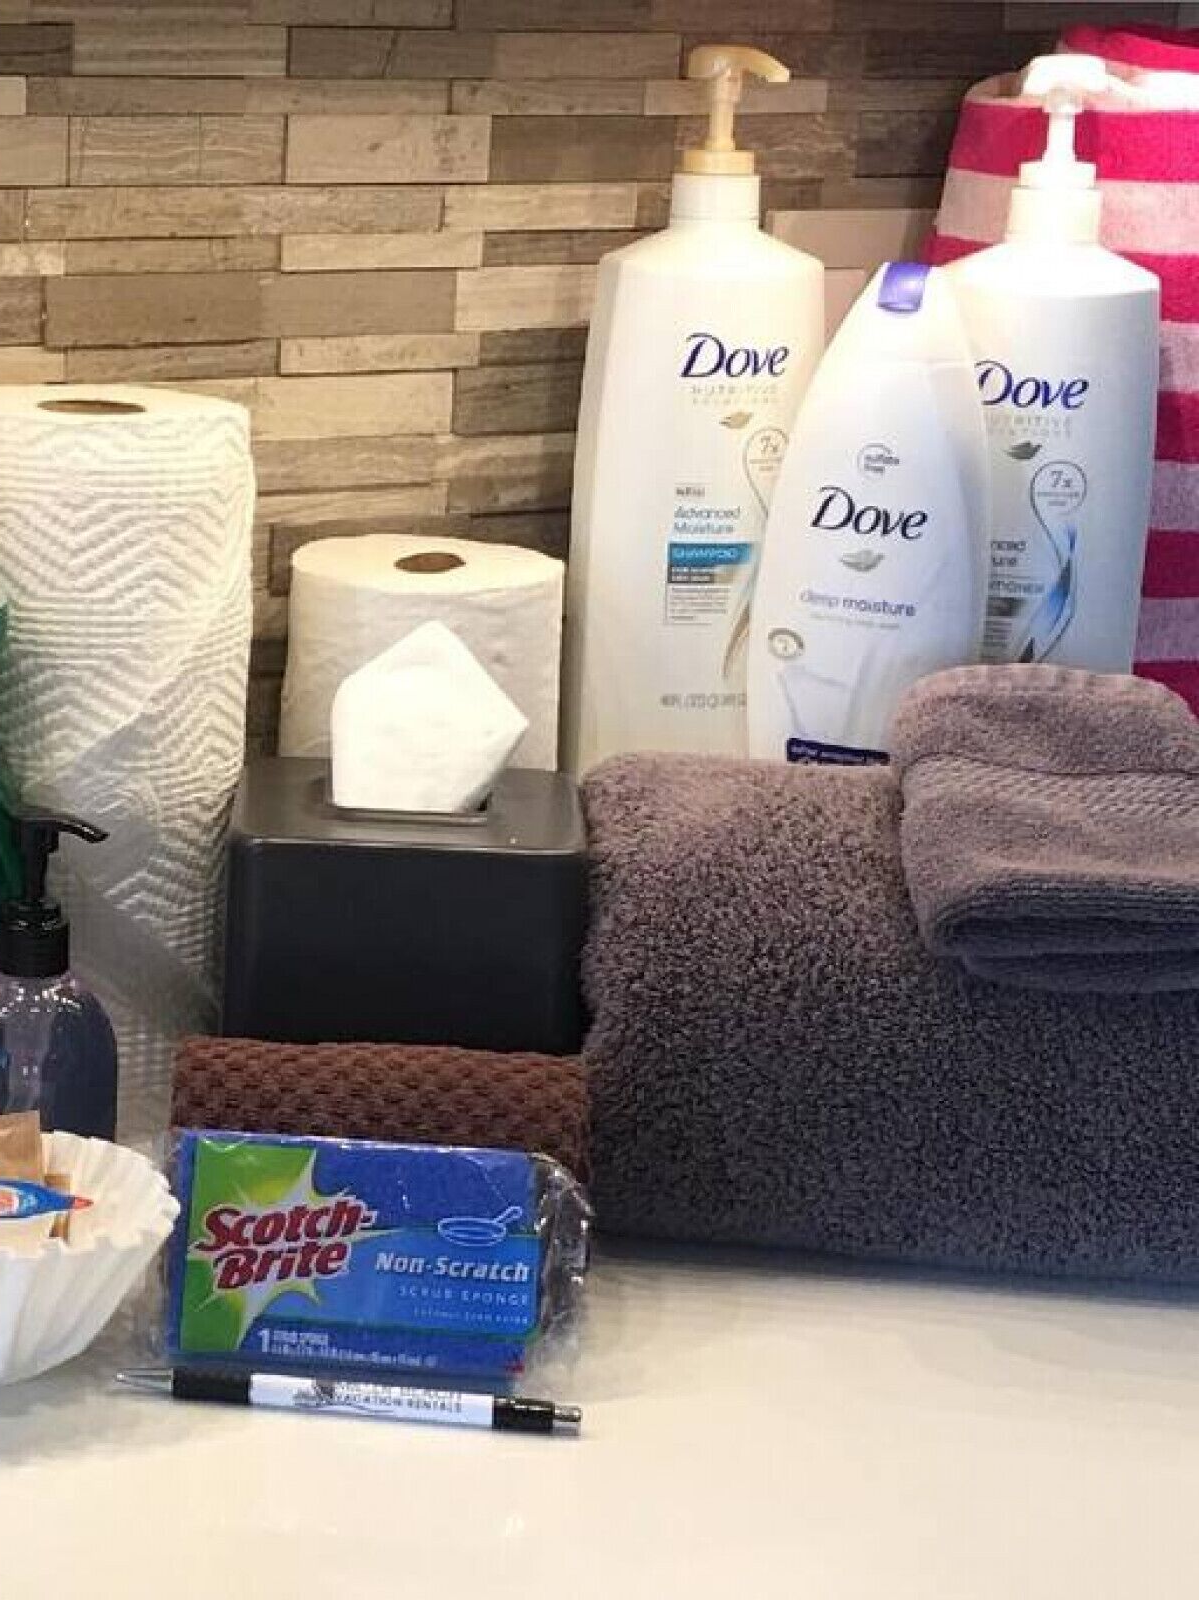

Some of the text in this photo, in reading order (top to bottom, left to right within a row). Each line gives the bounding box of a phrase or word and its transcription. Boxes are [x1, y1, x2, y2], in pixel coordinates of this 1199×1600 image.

[680, 332, 789, 378] Dove
[974, 360, 1089, 409] Dove
[811, 485, 928, 541] Dove
[842, 598, 917, 618] moisture
[213, 1242, 349, 1289] Brite
[376, 1251, 530, 1283] Non-Scratch
[398, 1285, 453, 1299] SCRUB
[257, 1327, 271, 1353] 1
